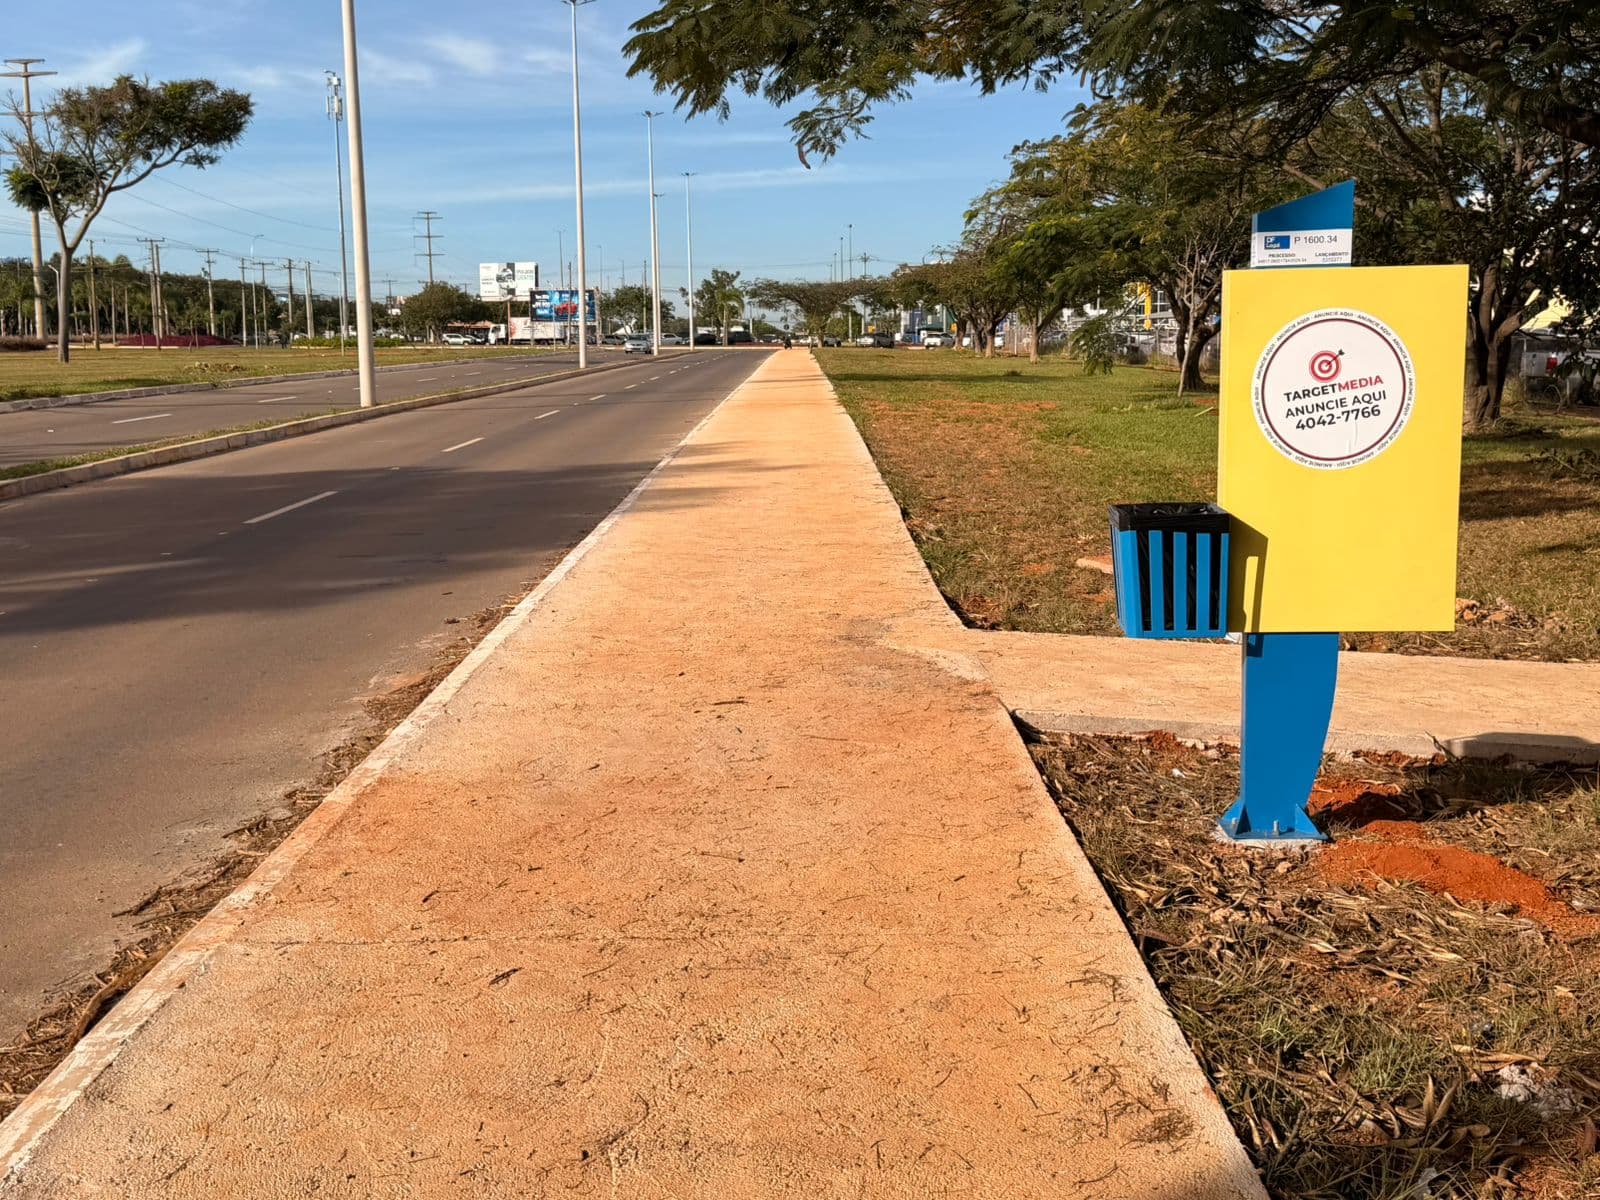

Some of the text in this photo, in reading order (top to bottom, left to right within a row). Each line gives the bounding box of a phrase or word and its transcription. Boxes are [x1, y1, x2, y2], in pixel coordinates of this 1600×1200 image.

[1304, 235, 1338, 244] 1600.34
[1283, 375, 1384, 402] TARGETMEDIA
[1285, 390, 1387, 419] ANUNCIE AQUI
[1295, 405, 1381, 430] 4042-7766
